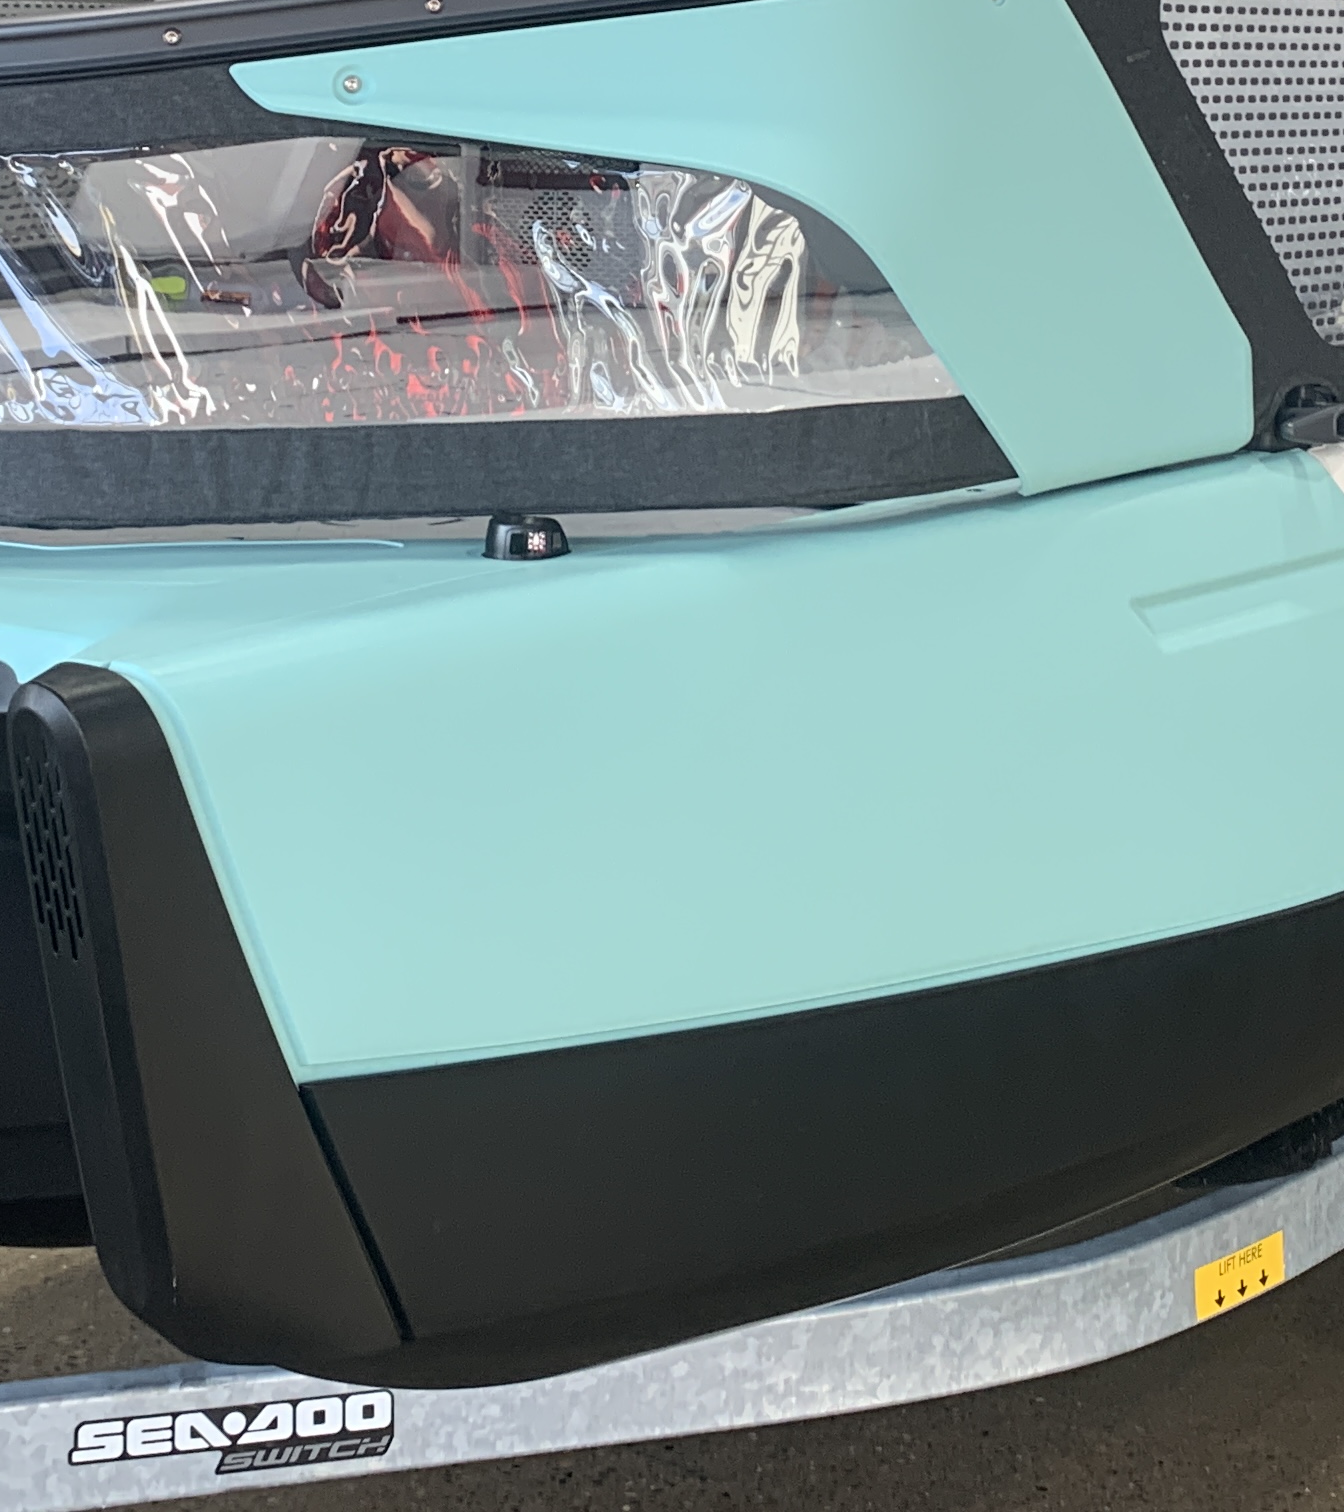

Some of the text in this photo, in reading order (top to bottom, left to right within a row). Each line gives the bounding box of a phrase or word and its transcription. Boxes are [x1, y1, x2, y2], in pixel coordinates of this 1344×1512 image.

[1218, 1243, 1263, 1276] LIFT HERE
[219, 1435, 392, 1472] SWITCH
